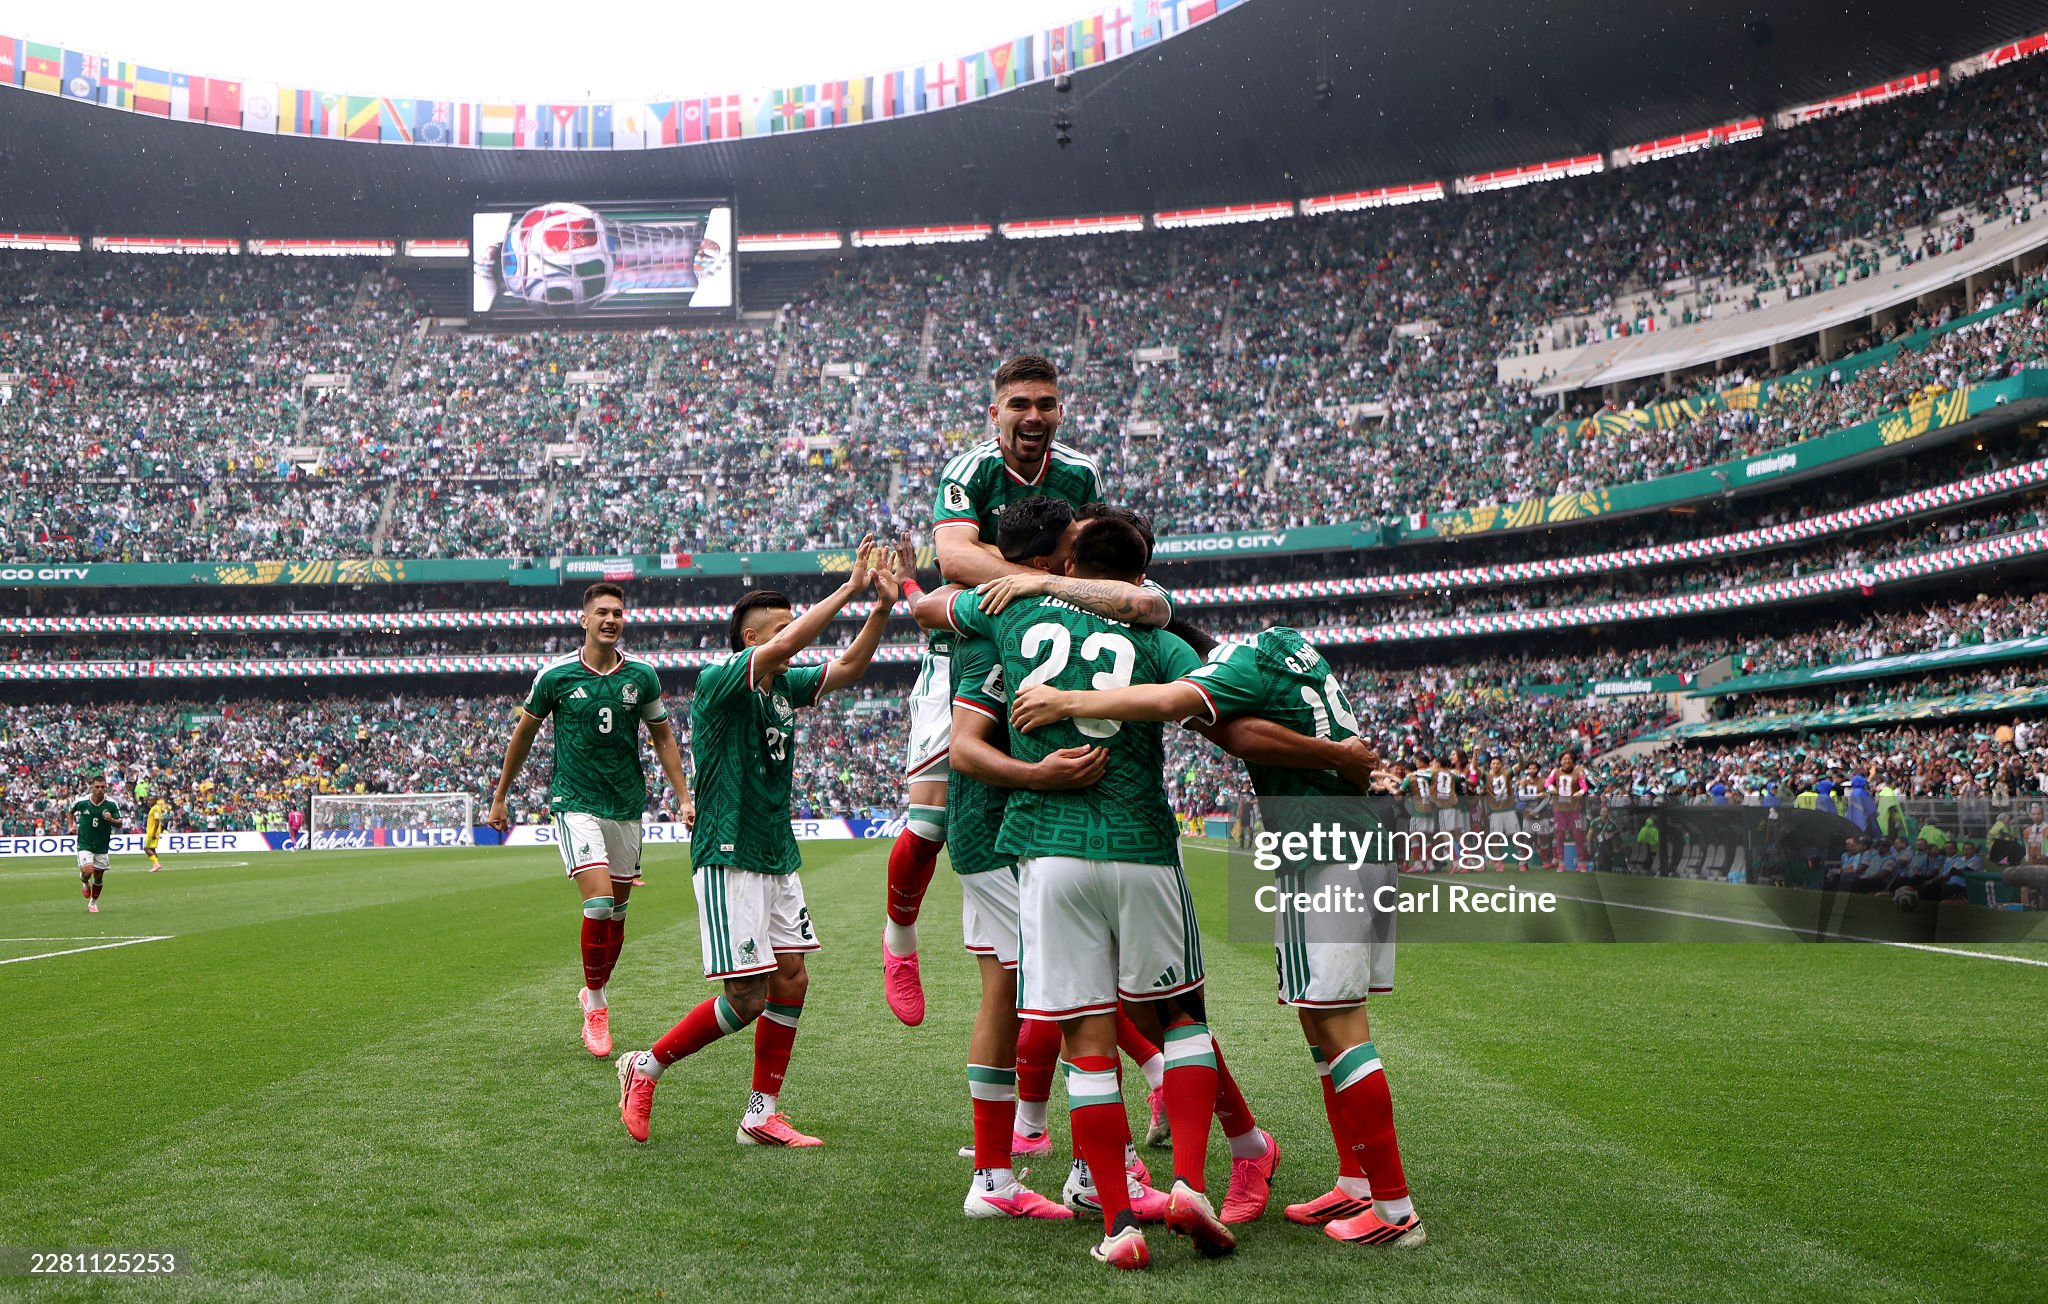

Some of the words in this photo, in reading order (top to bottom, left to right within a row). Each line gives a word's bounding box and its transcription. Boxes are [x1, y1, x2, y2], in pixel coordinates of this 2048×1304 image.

[1746, 453, 1796, 478] #FIFAWorldCup
[1152, 537, 1233, 553] MEXICO
[1237, 534, 1287, 549] CITY
[0, 568, 34, 580] CO
[38, 568, 89, 580] CITY
[1018, 622, 1135, 738] 23
[1594, 680, 1653, 695] #FIFAWorldCup
[598, 708, 612, 733] 3
[92, 817, 99, 828] 6
[168, 834, 237, 850] BEER
[392, 829, 473, 847] ULTRA
